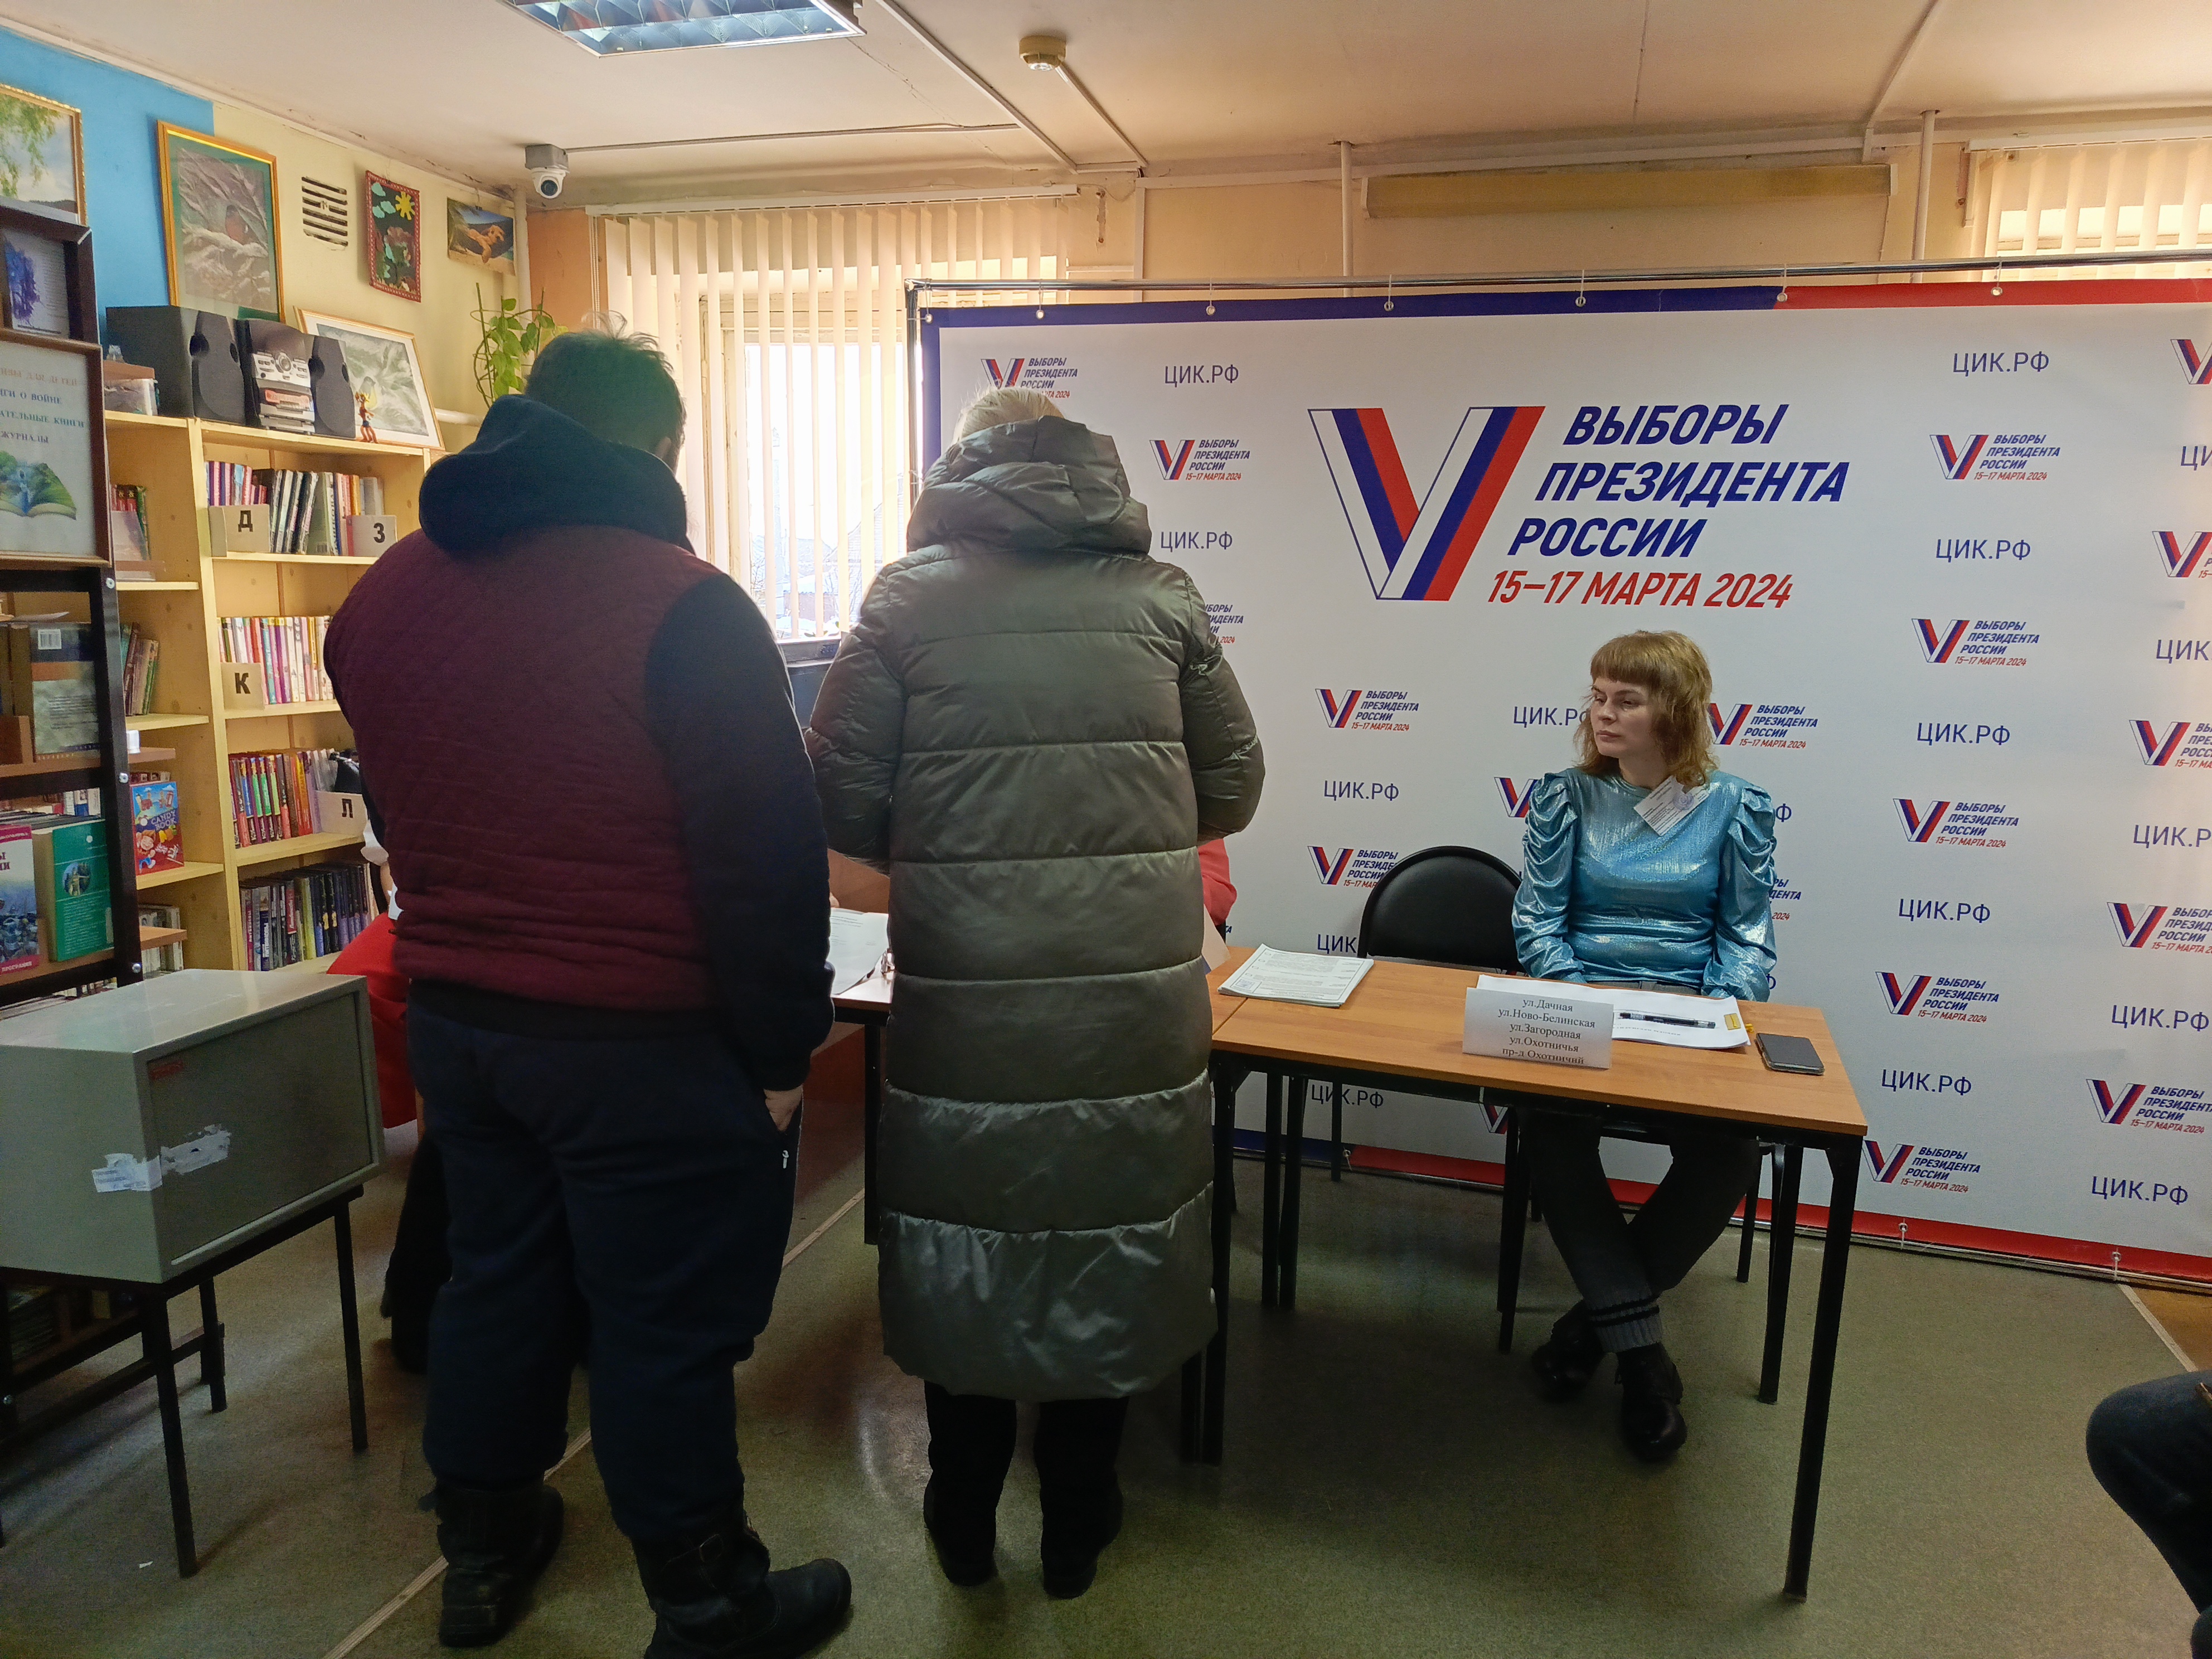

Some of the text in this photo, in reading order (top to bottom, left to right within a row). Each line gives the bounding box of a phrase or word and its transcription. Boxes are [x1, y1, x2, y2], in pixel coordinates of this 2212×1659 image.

[1029, 358, 1067, 366] ВЫБОРЫ
[1953, 352, 2049, 376] ЦИК.РФ
[1024, 369, 1078, 378] ПРЕЗИДЕНТА
[1165, 364, 1239, 386] ЦИК.РФ
[20, 391, 27, 400] О
[31, 392, 62, 404] ВОЙНЕ
[54, 417, 85, 428] КНИГИ
[1563, 404, 1789, 445] ВЫБОРЫ
[1199, 439, 1239, 449] ВЫБОРЫ
[1993, 435, 2046, 444] ВЫБОРЫ
[1194, 450, 1250, 462] ПРЕЗИДЕНТА
[1986, 446, 2060, 458] ПРЕЗИДЕНТА
[1189, 462, 1225, 470] РОССИИ
[1979, 459, 2027, 469] РОССИИ
[1204, 472, 1224, 481] МАРТА
[1225, 472, 1241, 481] 2024
[1997, 472, 2025, 481] МАРТА
[2026, 472, 2048, 481] 2024
[1535, 462, 1850, 507] ПРЕЗИДЕНТА
[238, 510, 254, 533] Д
[1160, 530, 1233, 552] ЦИК.РФ
[1508, 518, 1706, 557] РОССИИ
[1936, 539, 2031, 562] ЦИК.РФ
[1581, 571, 1702, 607] МАРТА
[1704, 573, 1793, 608] 2024
[1973, 620, 2026, 630] ВЫБОРЫ
[1967, 633, 2039, 644] ПРЕЗИДЕНТА
[1960, 644, 2006, 654] РОССИИ
[2156, 639, 2212, 664] ЦИК
[1978, 657, 2005, 666] МАРТА
[2006, 658, 2026, 666] 2024
[235, 672, 251, 695] К
[1365, 690, 1408, 700] ВЫБОРЫ
[1360, 701, 1419, 712] ПРЕЗИДЕНТА
[1757, 705, 1806, 715] ВЫБОРЫ
[1355, 712, 1393, 721] РОССИИ
[1750, 716, 1818, 727] ПРЕЗИДЕНТА
[1370, 723, 1391, 731] МАРТА
[1392, 724, 1410, 732] 2024
[1744, 727, 1788, 738] РОССИИ
[1917, 722, 2010, 746] ЦИК.РФ
[1760, 739, 1787, 748] МАРТА
[2181, 748, 2212, 758] РОСС
[1324, 780, 1399, 802] ЦИК.РФ
[342, 798, 353, 818] Л
[1954, 802, 2006, 814] ВЫБОРЫ
[151, 810, 176, 825] CANDY
[1948, 814, 2019, 827] ПРЕЗИДЕНТА
[155, 818, 177, 831] BOOK
[1941, 825, 1987, 837] РОССИИ
[2133, 824, 2212, 849] ЦИК.Р
[1959, 838, 1987, 847] МАРТА
[1987, 839, 2006, 848] 2024
[1357, 850, 1399, 860] ВЫБОРЫ
[1352, 860, 1396, 870] ПРЕЗИДЕ
[1772, 912, 1791, 921] 2024
[1899, 898, 1991, 923] ЦИК.РФ
[2172, 907, 2212, 919] ВЫБОР
[2165, 919, 2212, 932] ПРЕЗИД
[2157, 931, 2206, 942] РОССИИ
[1317, 934, 1357, 954] ЦИК
[2175, 944, 2205, 953] МАРТА
[1936, 977, 1986, 989] ВЫБОРЫ
[1929, 988, 1999, 1002] ПРЕЗИДЕНТА
[1522, 1000, 1573, 1012] ул.Дачная
[1923, 1000, 1967, 1011] РОССИИ
[1497, 1008, 1595, 1029] ул.Ново-Белинская
[1941, 1011, 1967, 1021] МАРТА
[1968, 1013, 1987, 1023] 2024
[2112, 1005, 2209, 1032] ЦИК.РФ
[1510, 1023, 1581, 1040] ул.Загородная
[1509, 1036, 1579, 1052] ул.Охотничья
[1502, 1047, 1584, 1065] пр-д Охотничий
[1881, 1069, 1972, 1095] ЦИК.РФ
[2151, 1086, 2205, 1099] ВЫБОРЫ
[2136, 1109, 2185, 1120] РОССИИ
[2155, 1122, 2183, 1132] МАРТА
[2183, 1124, 2205, 1134] 2024
[1918, 1147, 1968, 1160] ВЫБОРЫ
[1912, 1158, 1981, 1173] ПРЕЗИДЕНТА
[1906, 1168, 1950, 1181] РОССИИ
[1922, 1180, 1949, 1190] МАРТА
[1949, 1183, 1969, 1193] 2024
[2092, 1176, 2189, 1205] ЦИК.РФ
